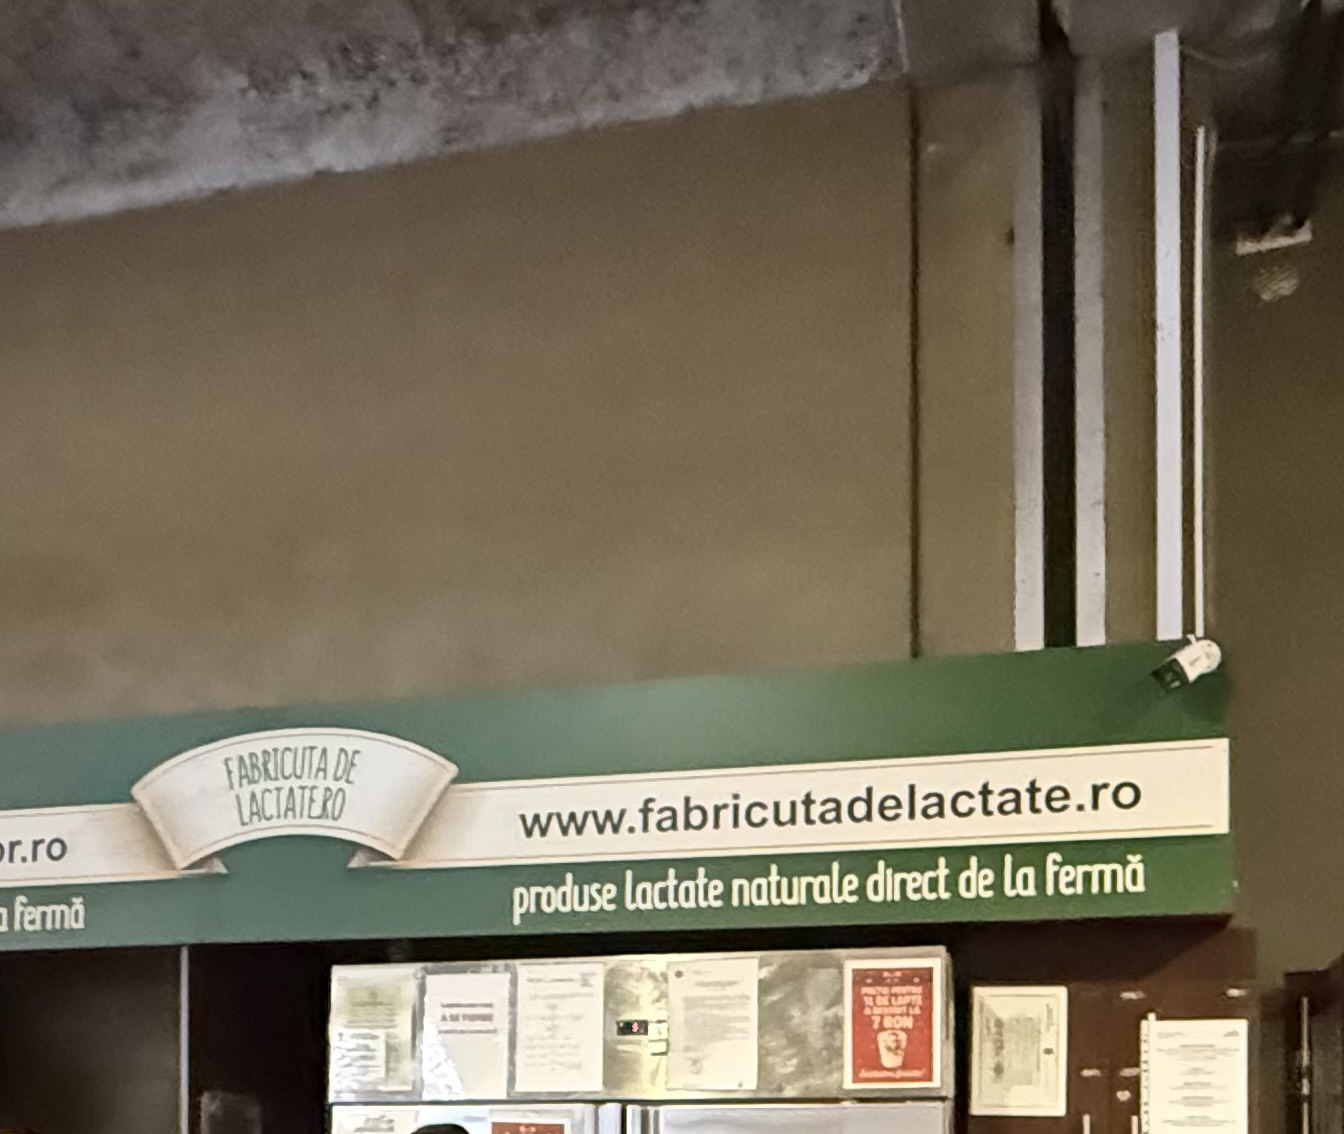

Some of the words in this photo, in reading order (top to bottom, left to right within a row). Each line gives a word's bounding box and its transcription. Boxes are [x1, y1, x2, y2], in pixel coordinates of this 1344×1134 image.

[223, 745, 328, 790] FABRICUTA
[333, 748, 361, 784] DE
[519, 780, 1143, 839] www.fabricutadelactate.ro
[14, 895, 86, 932] fermă
[513, 872, 617, 926] produse
[625, 865, 724, 911] lactate
[732, 858, 859, 907] naturale
[866, 856, 952, 902] direct
[958, 855, 994, 899] de
[1004, 853, 1037, 897] la
[1046, 851, 1147, 896] fermă
